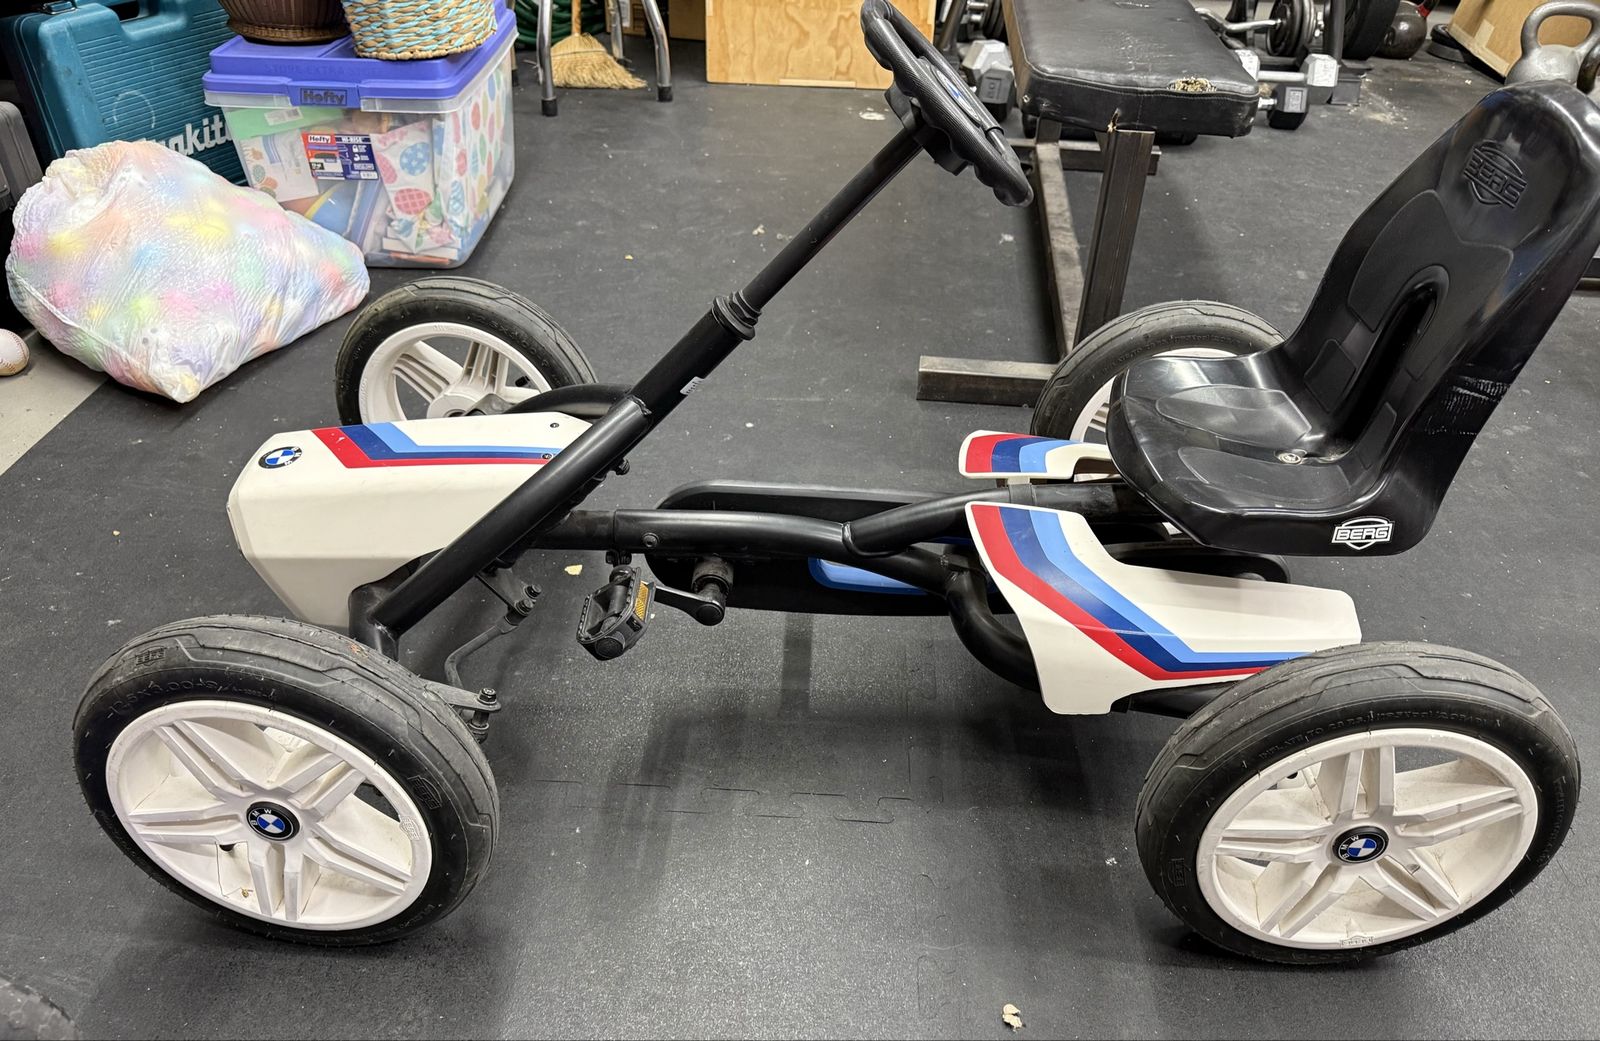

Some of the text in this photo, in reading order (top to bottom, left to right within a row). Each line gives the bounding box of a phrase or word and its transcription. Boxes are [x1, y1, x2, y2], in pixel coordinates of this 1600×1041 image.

[303, 88, 345, 104] Hefty
[141, 114, 231, 156] akit
[309, 135, 330, 144] Hefty
[1336, 527, 1389, 541] BERG
